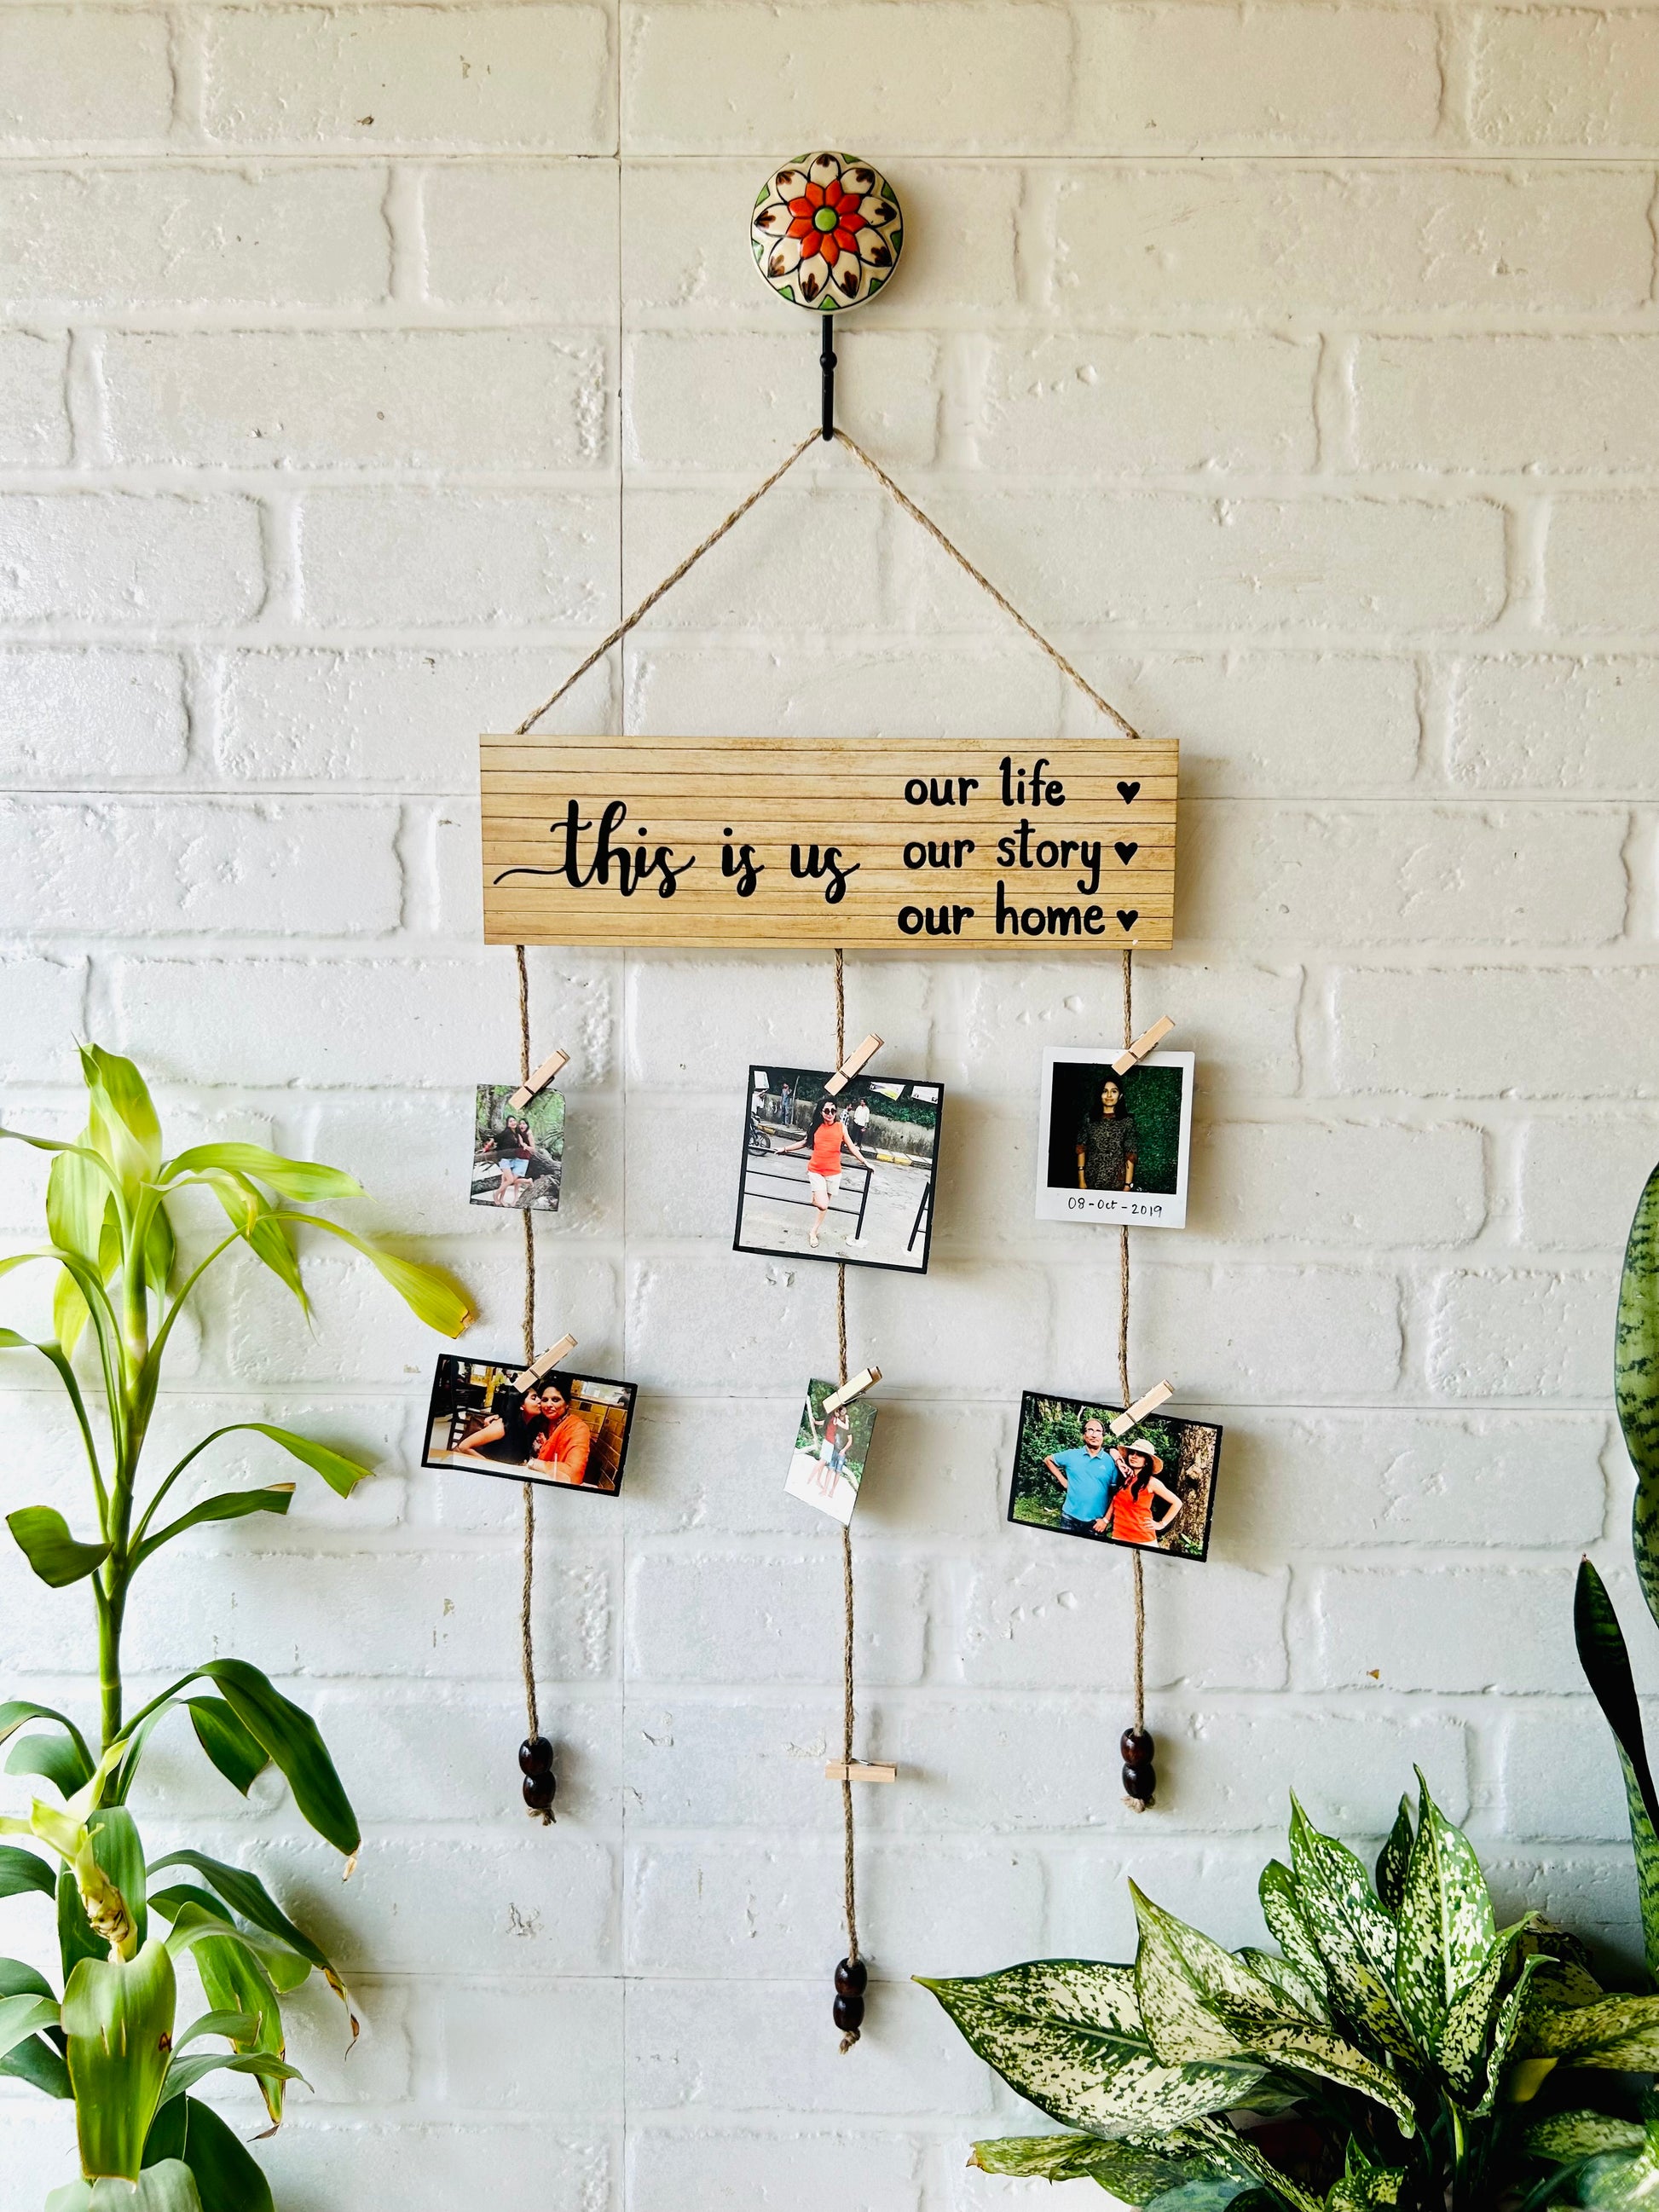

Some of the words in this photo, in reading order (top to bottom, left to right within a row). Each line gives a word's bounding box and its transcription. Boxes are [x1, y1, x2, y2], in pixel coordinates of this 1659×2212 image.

[904, 777, 978, 806] our
[998, 756, 1066, 807] life
[494, 800, 696, 898] this
[720, 827, 766, 898] is
[790, 844, 861, 904] us
[903, 840, 975, 869] our
[997, 818, 1101, 896] story
[897, 905, 974, 936] our
[996, 880, 1106, 936] home
